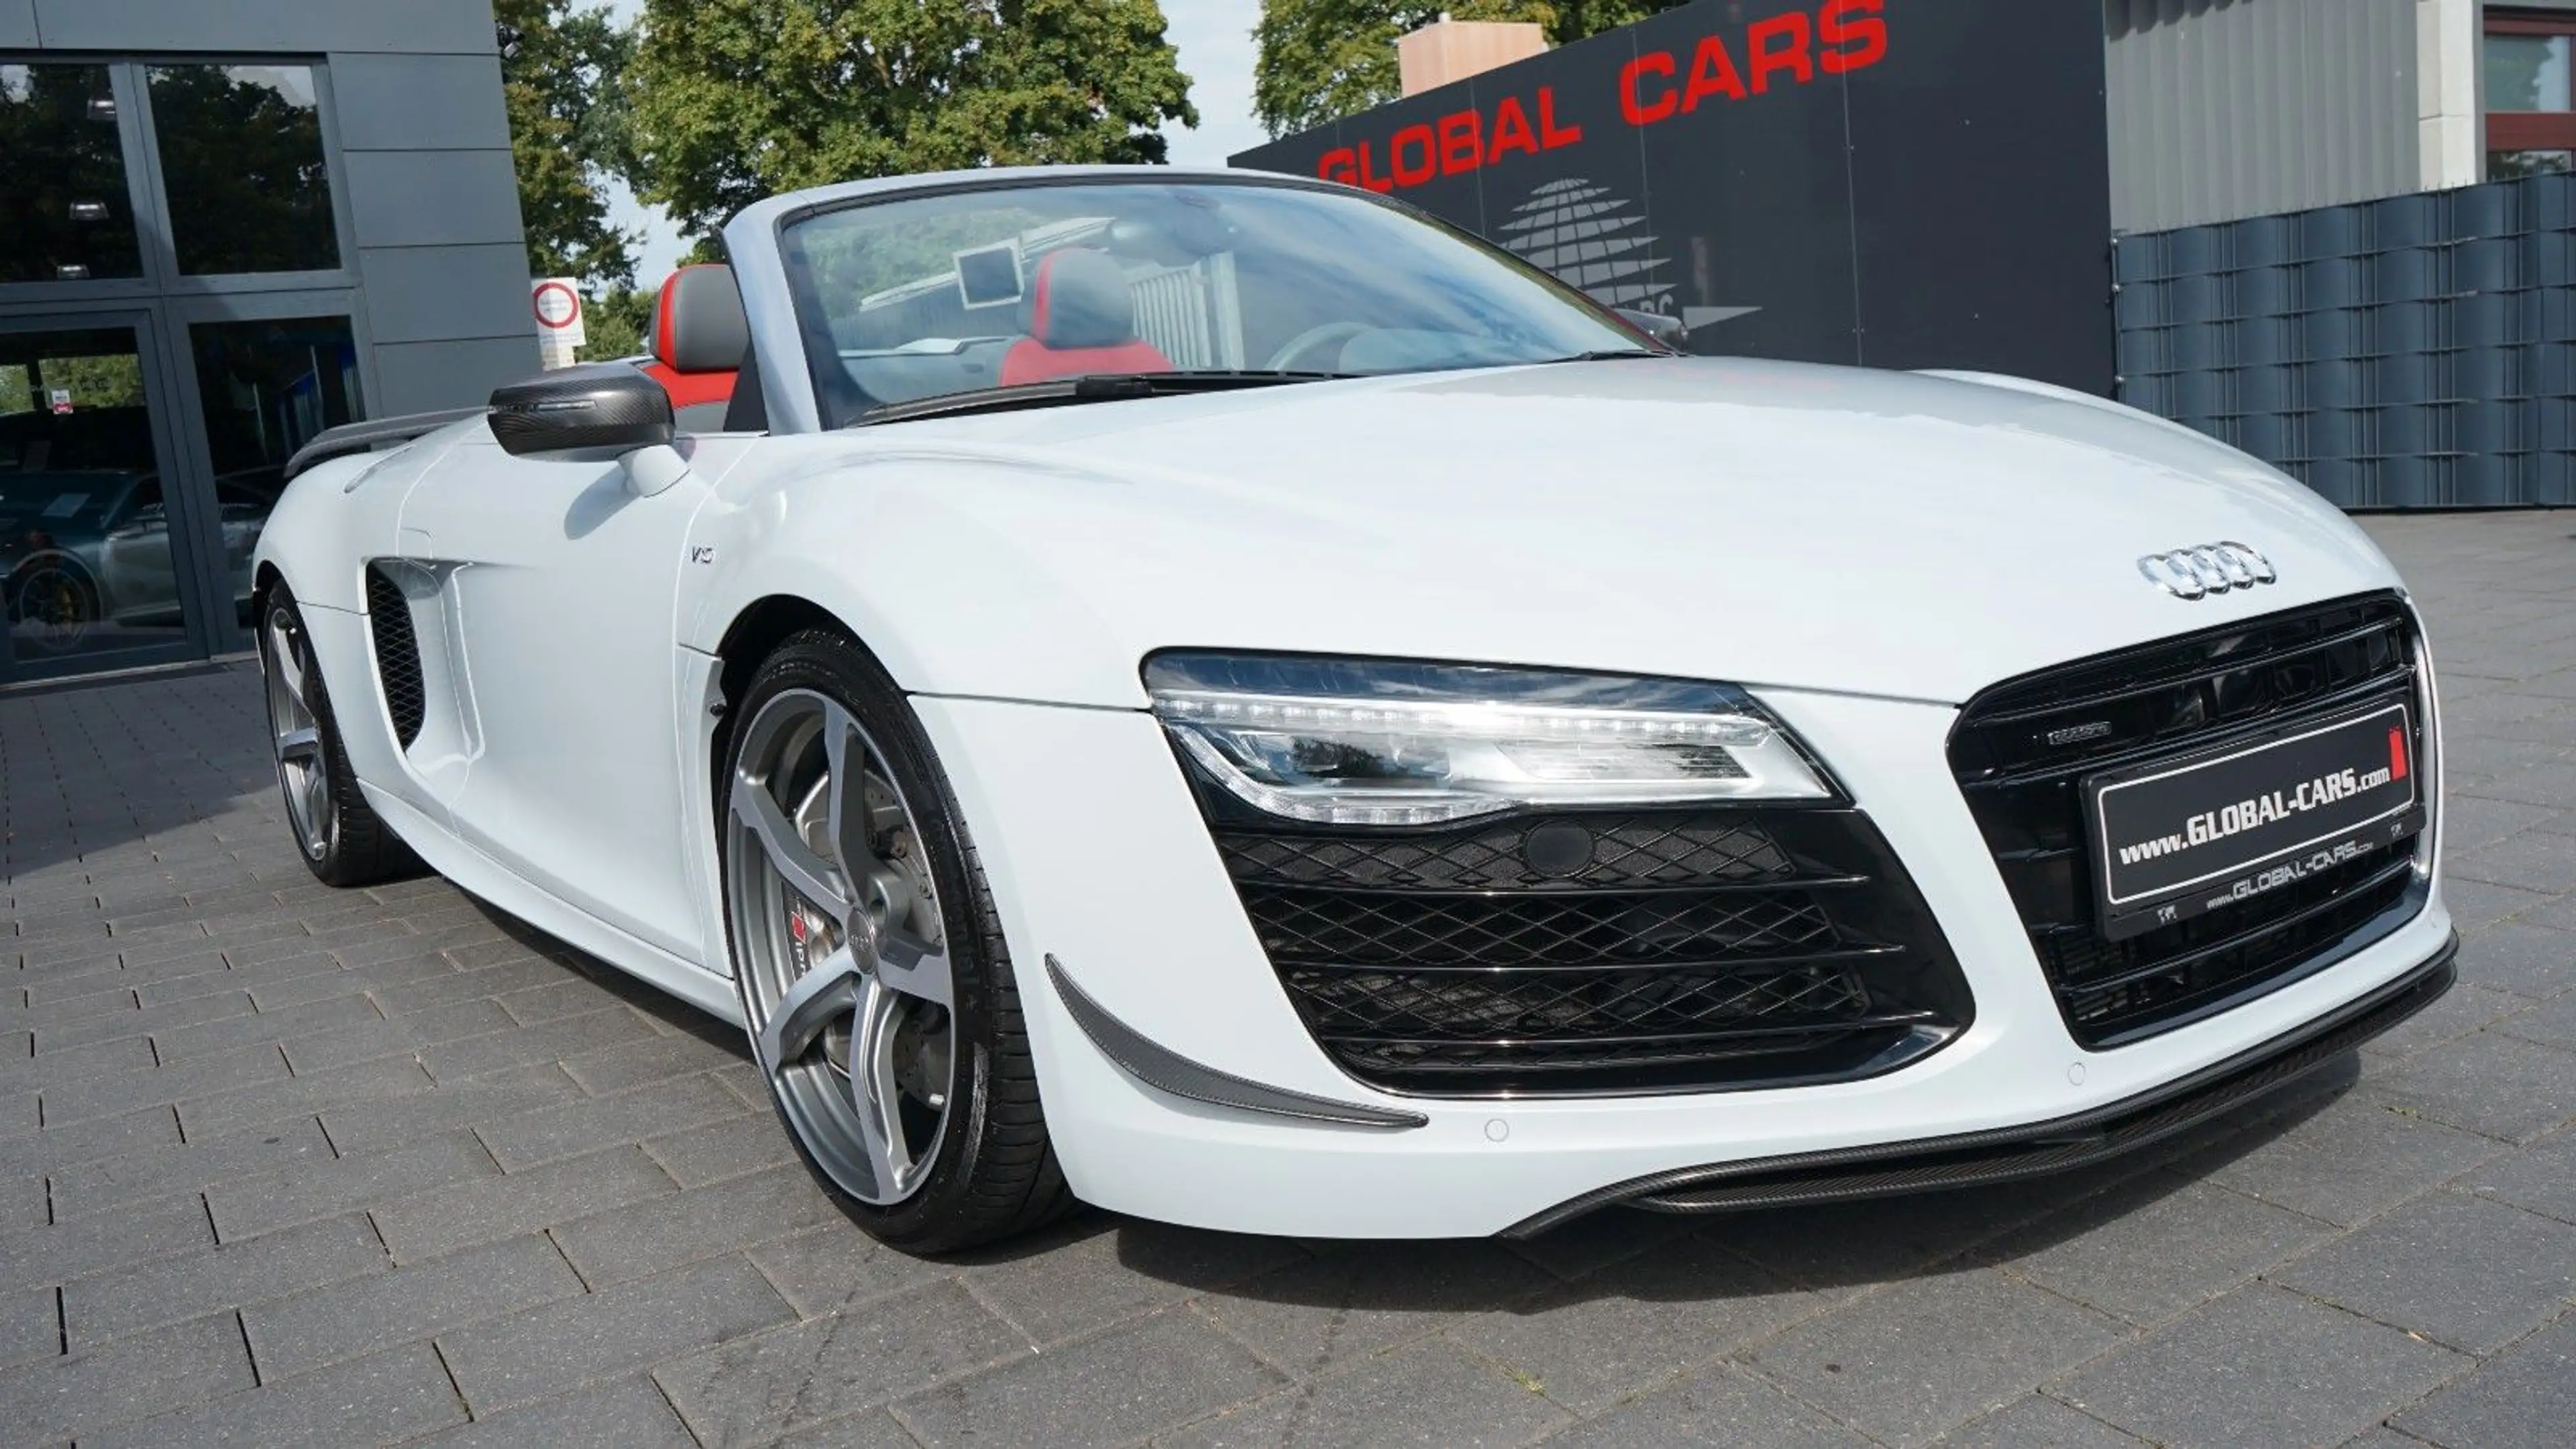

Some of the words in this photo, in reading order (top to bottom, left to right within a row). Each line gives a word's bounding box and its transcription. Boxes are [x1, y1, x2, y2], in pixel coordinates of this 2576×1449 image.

[1318, 85, 1582, 193] GLOBAL
[1619, 0, 1887, 126] CARS
[2118, 767, 2390, 865] www.GLOBAL-CARS.com
